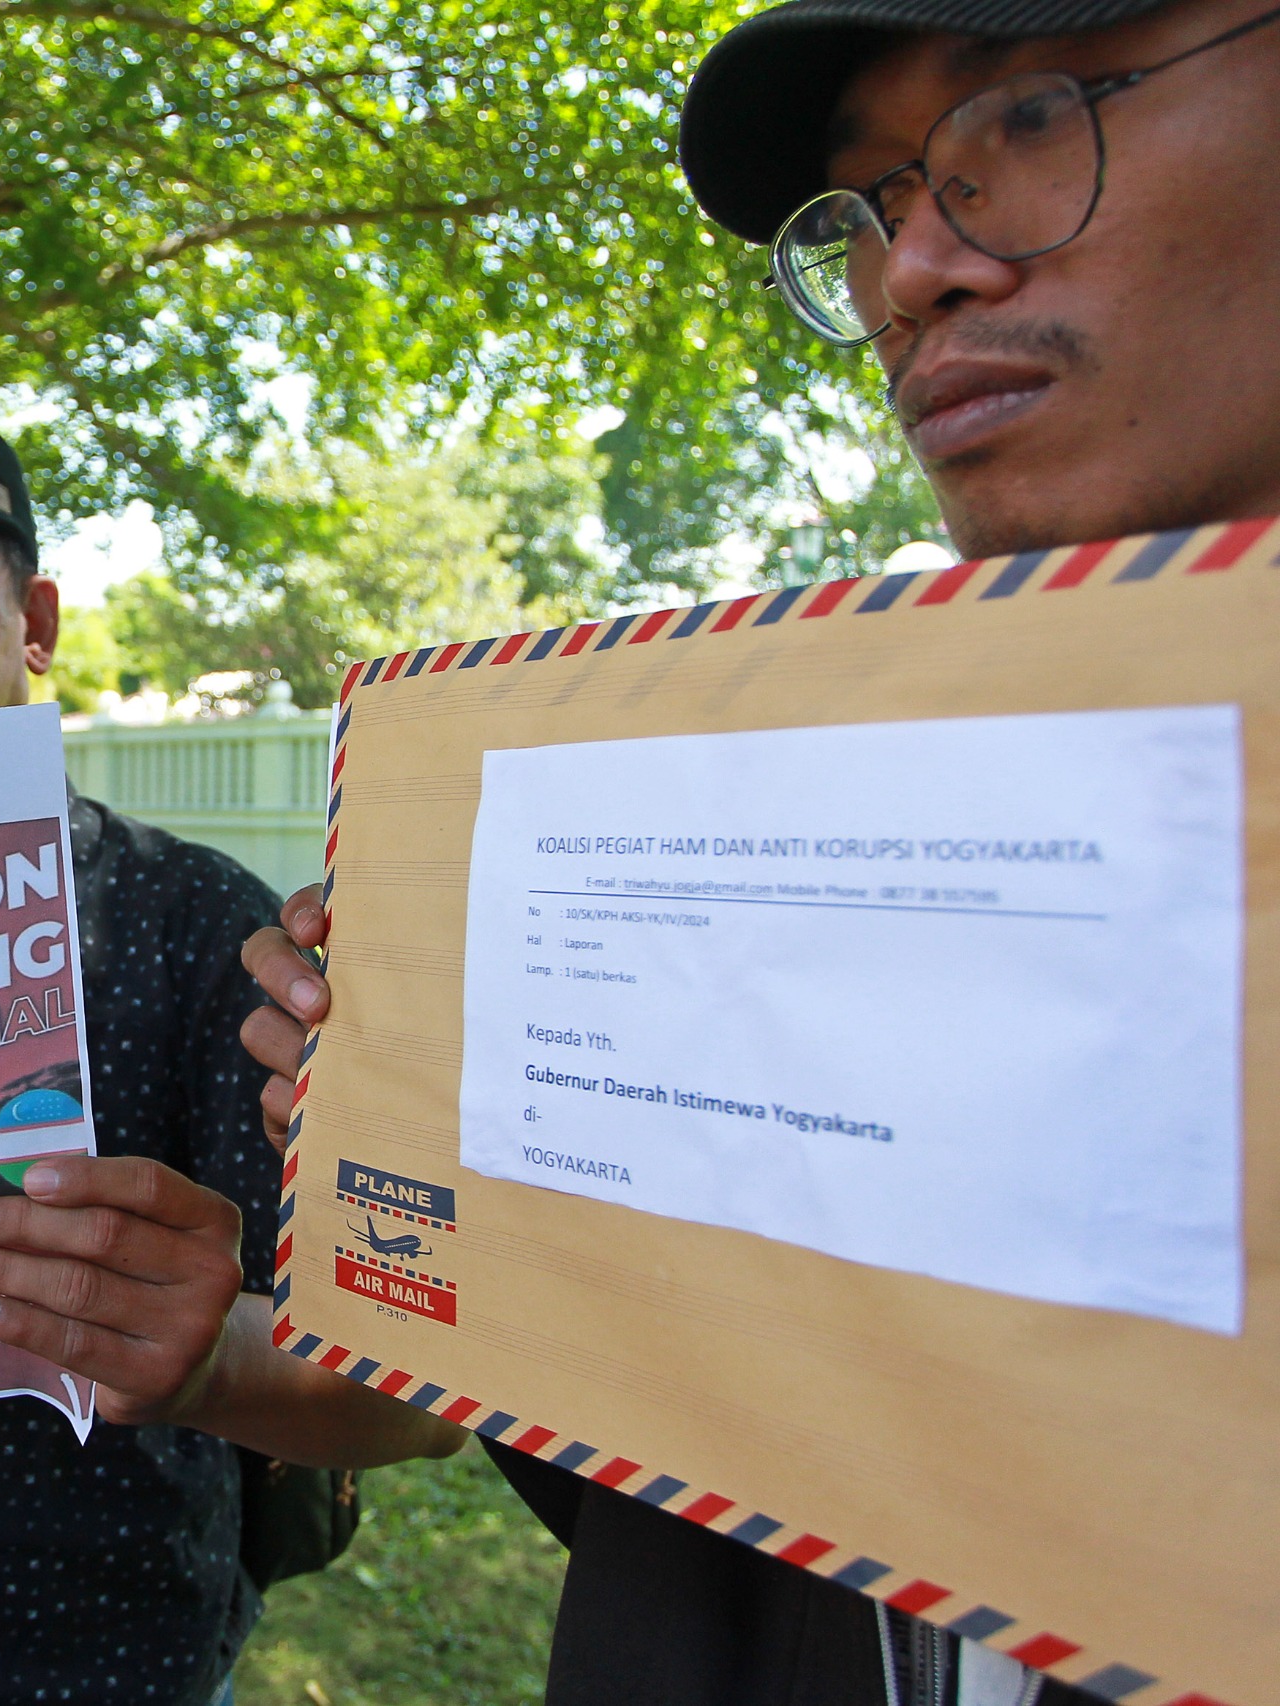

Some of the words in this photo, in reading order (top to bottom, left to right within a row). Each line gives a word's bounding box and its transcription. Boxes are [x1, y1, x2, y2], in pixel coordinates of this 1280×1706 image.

[537, 837, 591, 854] KOALISI
[596, 837, 655, 855] PEGIAT
[661, 837, 706, 855] HAM
[714, 838, 754, 856] DAN
[760, 838, 808, 857] ANTI
[815, 838, 915, 860] KORUPSI
[921, 839, 1105, 862] YOGYAKARTA
[586, 877, 616, 889] E-mail
[528, 906, 541, 917] No
[527, 935, 542, 946] Hal
[565, 937, 604, 951] Laporan
[526, 963, 554, 977] Lamp.
[573, 967, 600, 982] (satu)
[602, 971, 637, 984] berkas
[527, 1023, 581, 1046] Kepada
[586, 1031, 617, 1052] Yth.
[524, 1105, 542, 1122] di-
[525, 1064, 599, 1092] Gubernur
[604, 1077, 668, 1104] Daerah
[673, 1088, 766, 1120] Istimewa
[771, 1102, 894, 1142] Yogyakarta
[523, 1145, 632, 1185] YOGYAKARTA
[354, 1171, 432, 1209] PLANE
[353, 1271, 384, 1296] AIR
[389, 1281, 435, 1312] MAIL
[376, 1304, 408, 1322] P.310
